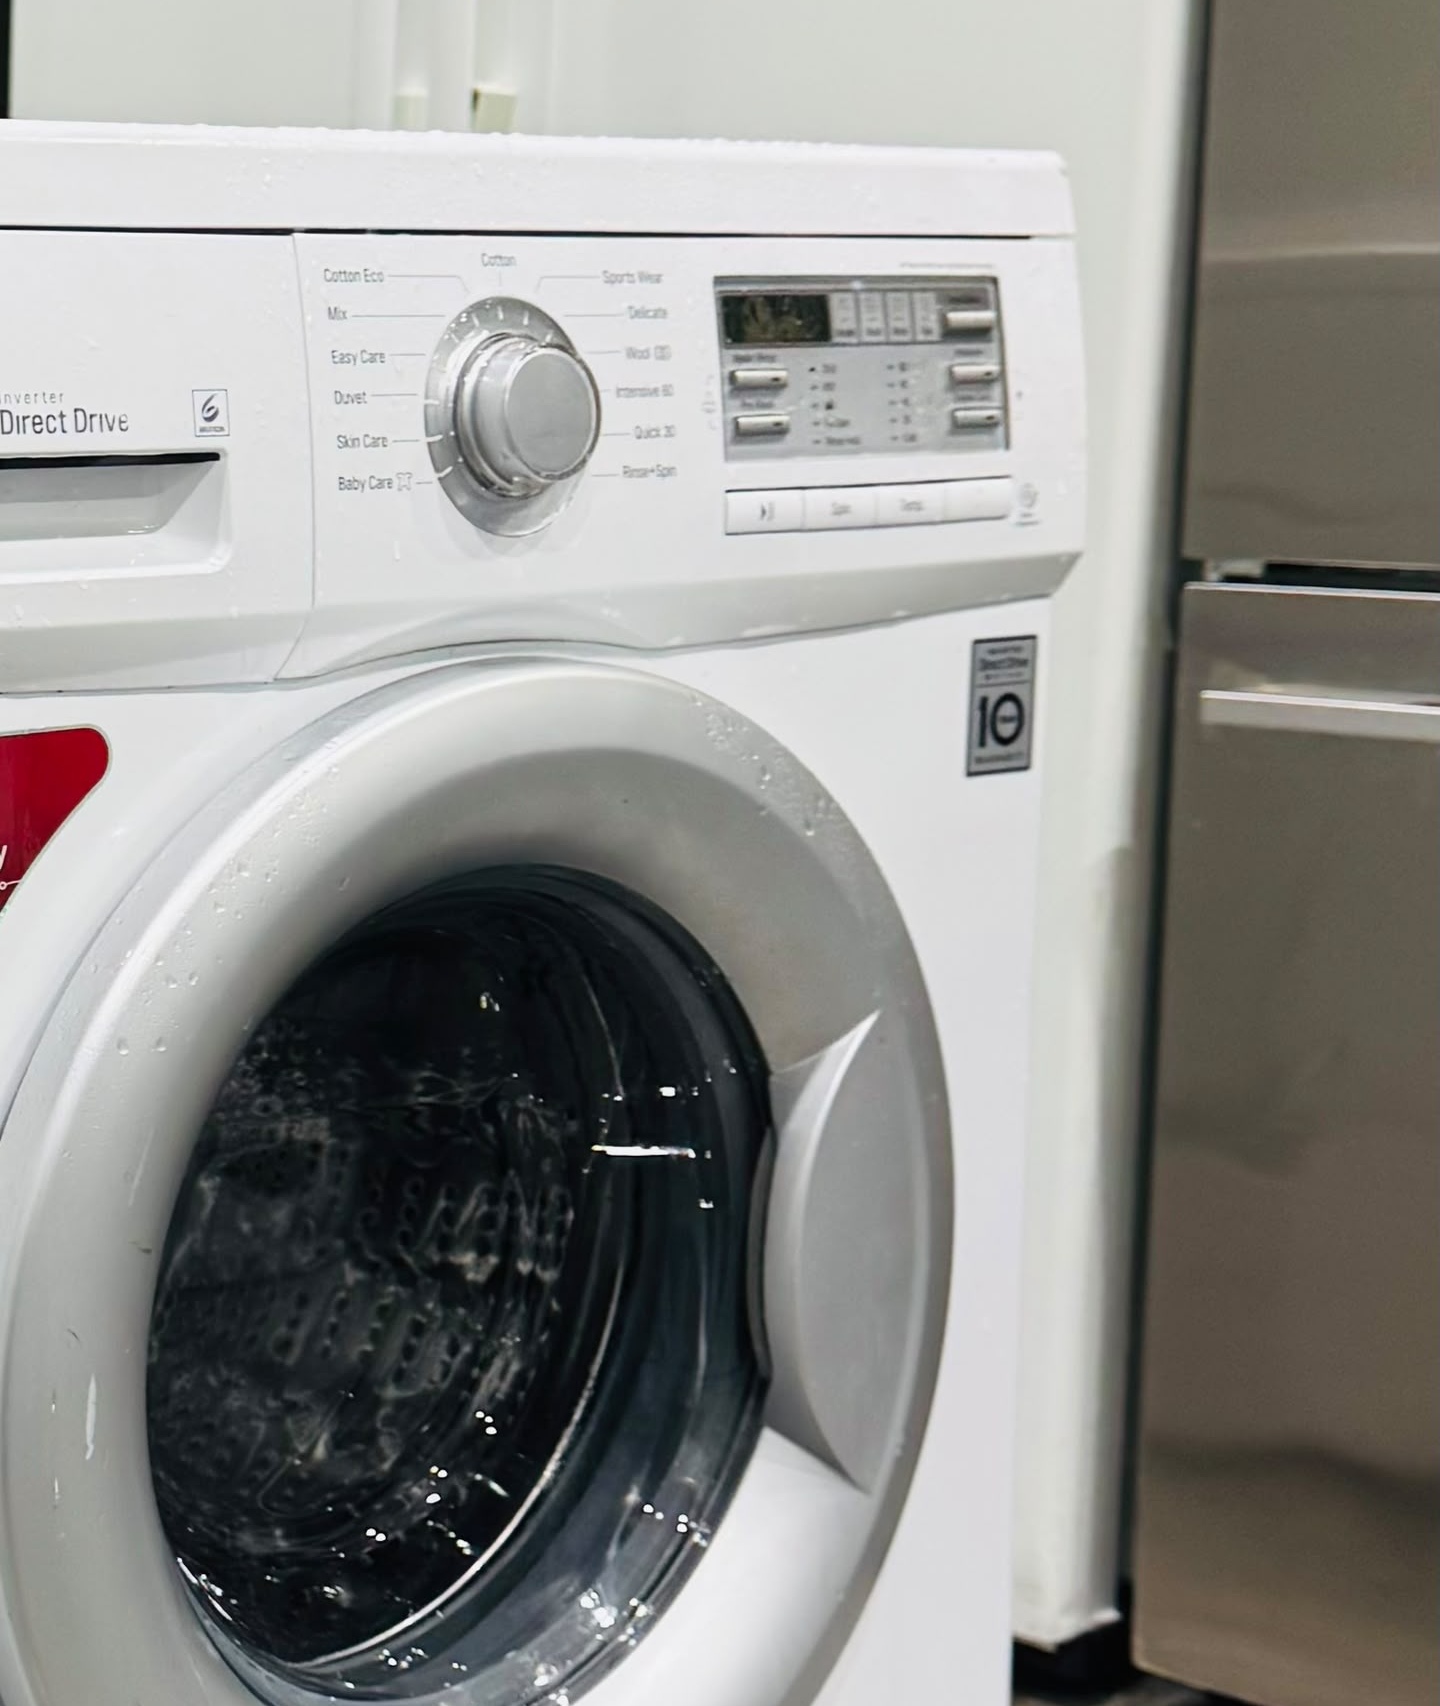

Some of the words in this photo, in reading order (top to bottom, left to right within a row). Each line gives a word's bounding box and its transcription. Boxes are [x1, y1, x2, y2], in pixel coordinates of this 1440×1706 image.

[323, 268, 361, 284] Cotton
[364, 268, 385, 283] Eco
[601, 270, 636, 286] Sports
[327, 306, 348, 321] Mix
[331, 350, 357, 366] Easy
[360, 349, 386, 364] Care
[334, 390, 367, 405] Duvet
[0, 409, 67, 435] Direct
[73, 407, 130, 433] Drive
[336, 435, 360, 449] Skin
[363, 434, 388, 448] Care
[338, 476, 367, 493] Baby
[368, 475, 393, 490] Care
[977, 692, 1025, 748] 10
